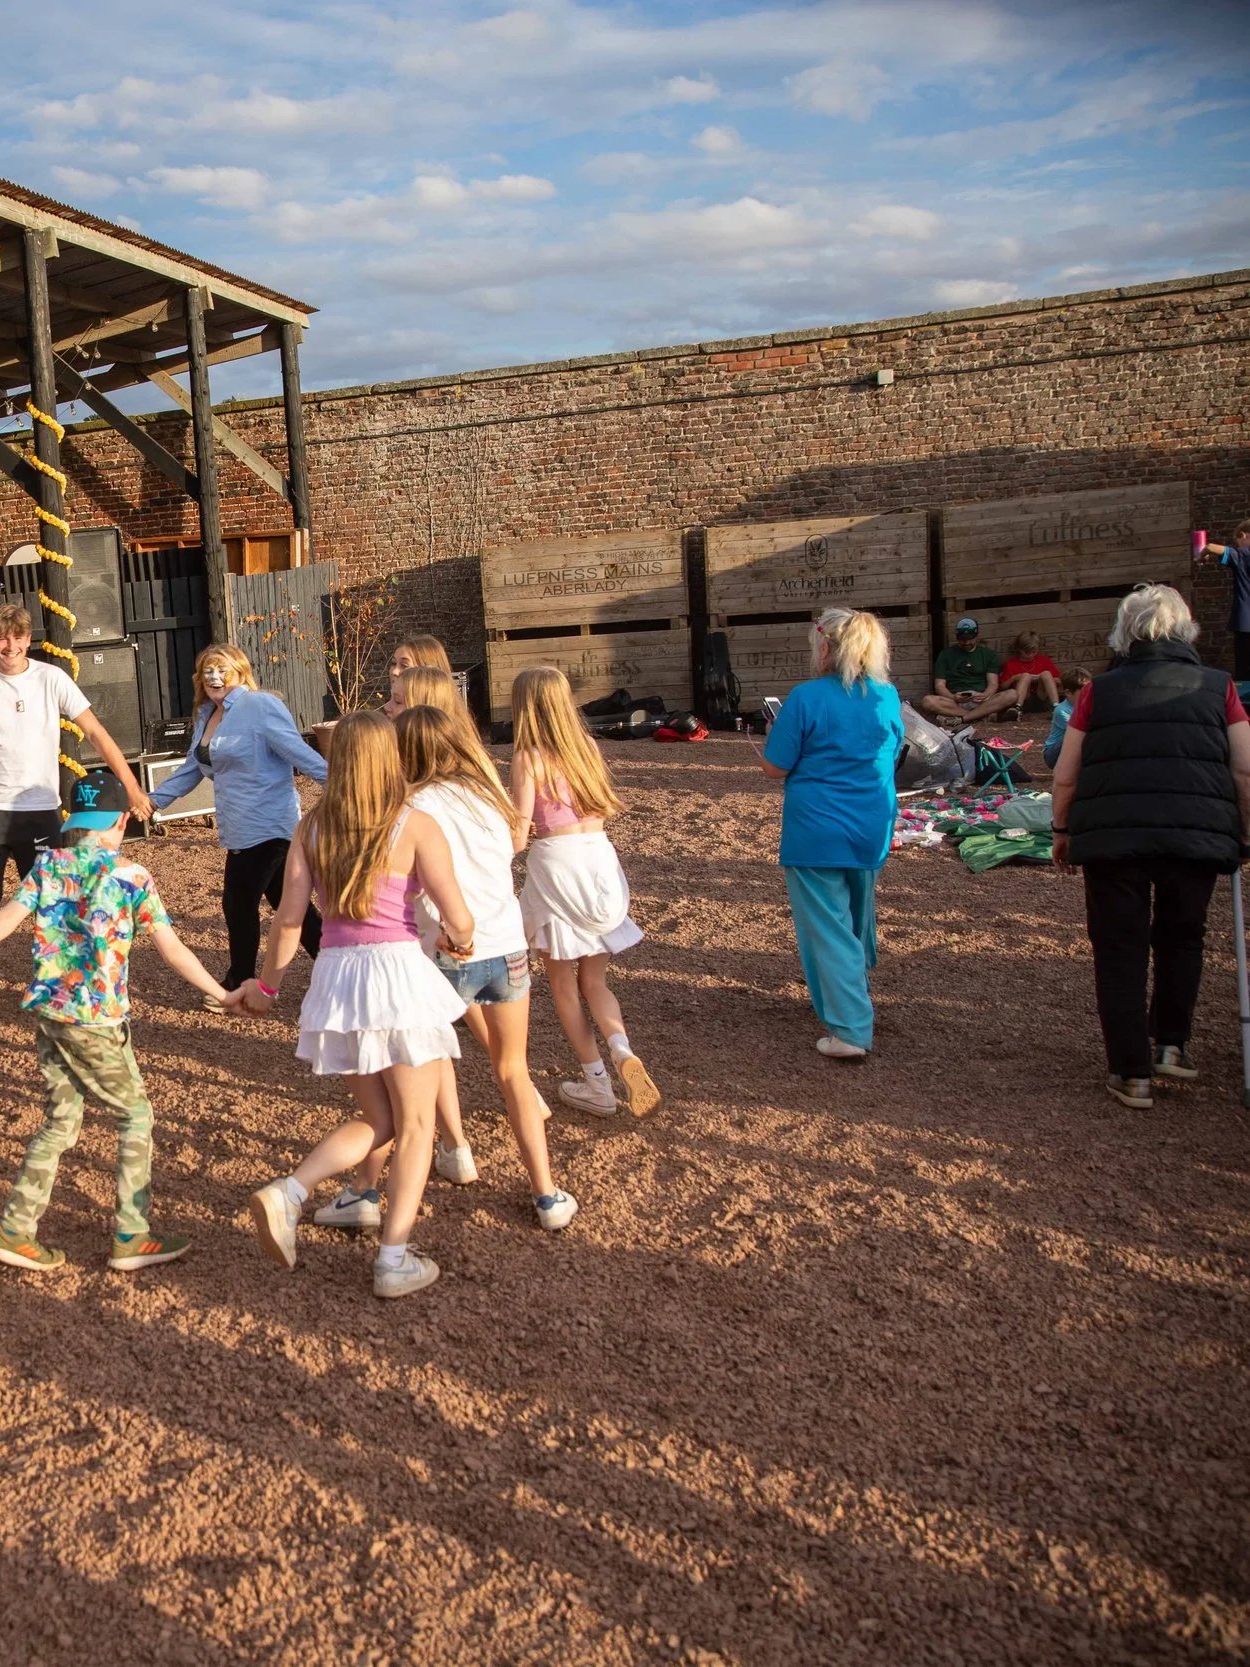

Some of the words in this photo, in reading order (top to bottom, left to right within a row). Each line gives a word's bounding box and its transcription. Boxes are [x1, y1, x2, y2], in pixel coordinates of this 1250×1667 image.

[604, 561, 663, 578] MAINS
[542, 579, 627, 596] ABERLADY
[779, 575, 855, 590] Archerfield
[736, 652, 812, 667] LUFFNE
[76, 784, 100, 807] NY
